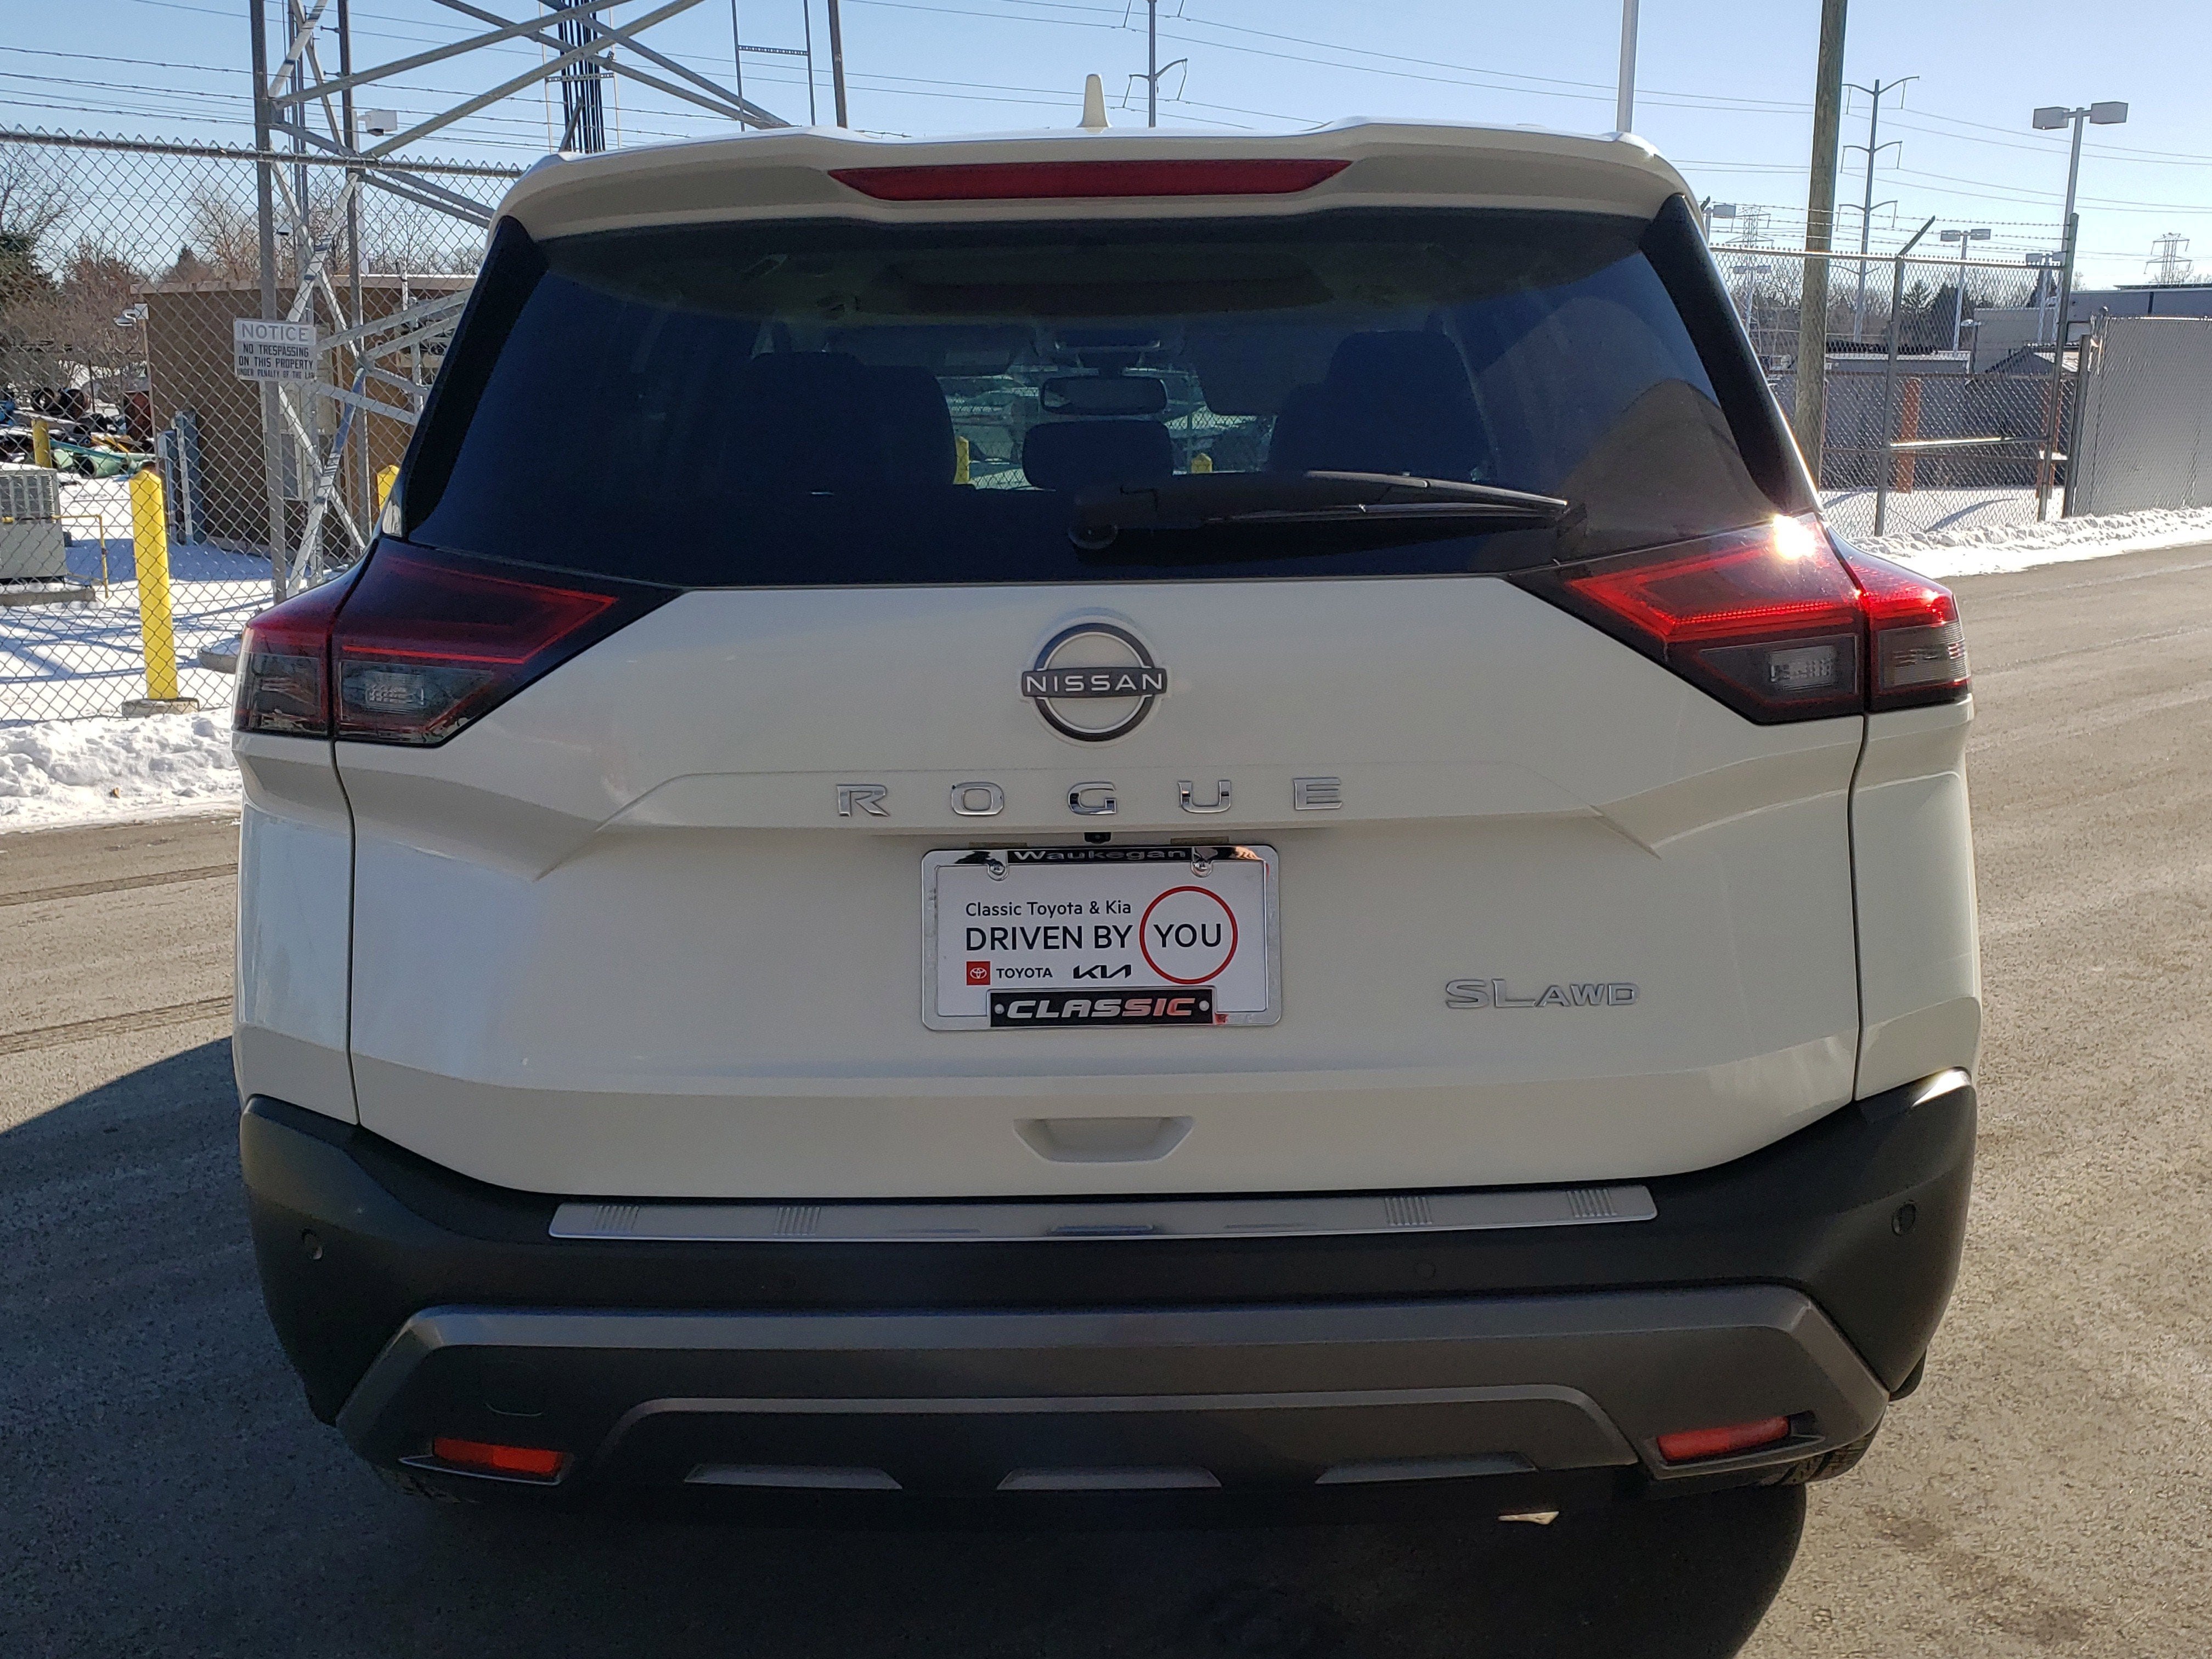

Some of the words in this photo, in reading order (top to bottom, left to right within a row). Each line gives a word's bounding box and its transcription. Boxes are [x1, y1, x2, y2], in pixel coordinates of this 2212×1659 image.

[241, 323, 309, 342] NOTICE
[243, 343, 253, 354] NO
[259, 345, 309, 357] TRESPASSING
[239, 356, 249, 366] ON
[255, 357, 271, 368] THIS
[275, 358, 313, 370] PROPERTY
[1025, 673, 1164, 693] NISSAN
[836, 777, 1343, 817] ROGUE
[1014, 849, 1186, 860] Waukegan
[966, 901, 1022, 917] Classic
[1026, 901, 1083, 919] Toyota
[1089, 901, 1101, 915] &
[1106, 900, 1132, 915] Kia
[966, 925, 1083, 951] DRIVEN
[1094, 924, 1133, 949] BY
[1153, 923, 1222, 948] YOU
[996, 967, 1053, 979] TOYOTA
[1073, 964, 1132, 980] KIA
[1006, 997, 1196, 1019] CLASSIC
